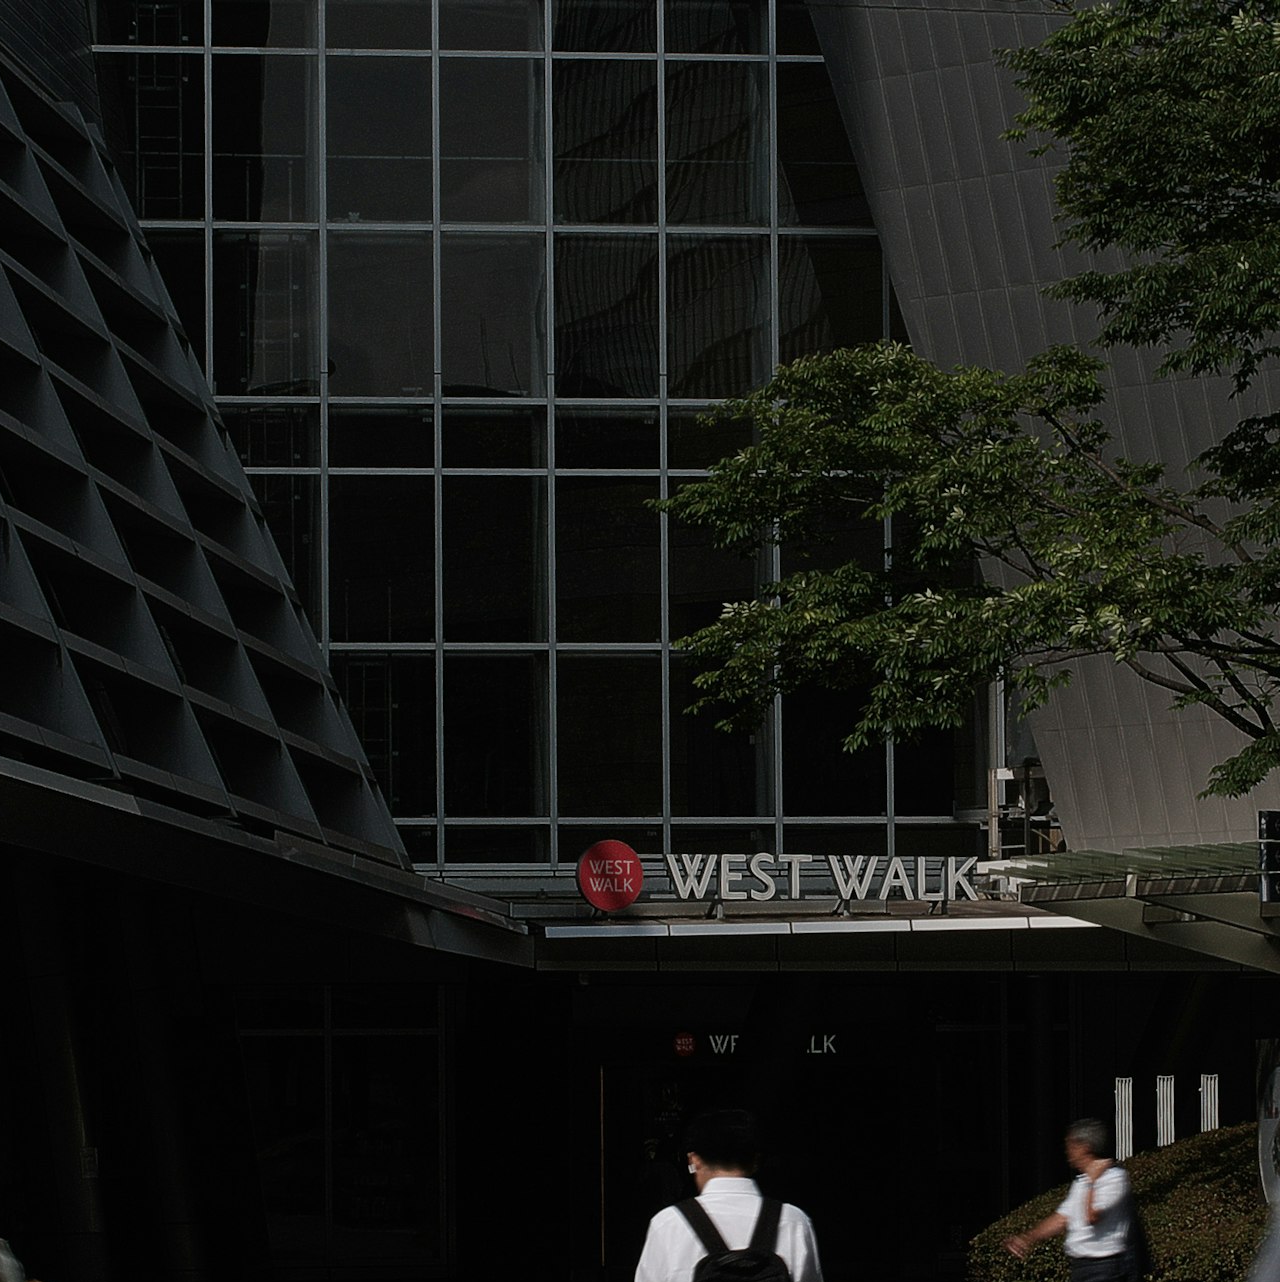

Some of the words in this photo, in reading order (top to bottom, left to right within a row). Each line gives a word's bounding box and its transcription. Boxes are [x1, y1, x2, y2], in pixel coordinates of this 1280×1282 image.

[589, 859, 635, 875] WEST
[590, 878, 634, 893] WALK
[666, 852, 813, 901] WEST
[827, 855, 979, 901] WALK
[806, 1034, 838, 1054] LK
